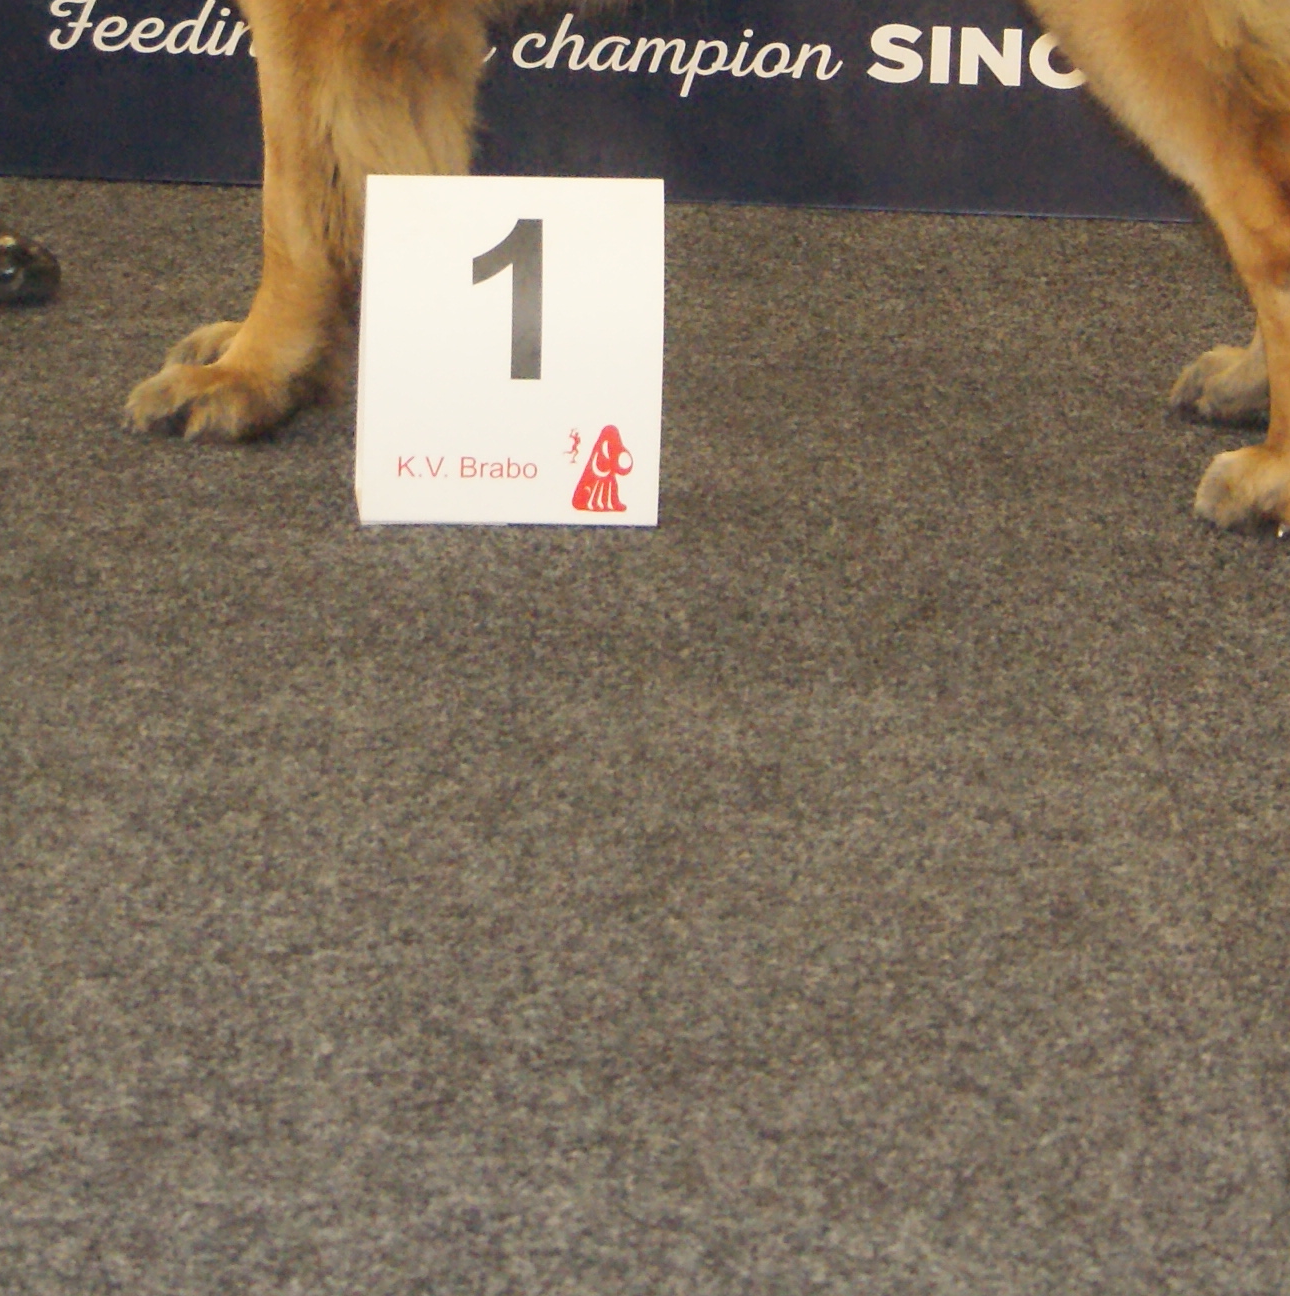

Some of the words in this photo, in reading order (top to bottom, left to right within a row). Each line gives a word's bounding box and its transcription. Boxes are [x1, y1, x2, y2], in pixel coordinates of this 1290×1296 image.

[512, 13, 843, 98] champion
[866, 23, 1087, 90] SINC
[472, 218, 543, 380] 1
[397, 456, 448, 478] K.V.
[460, 456, 538, 479] Brabo
